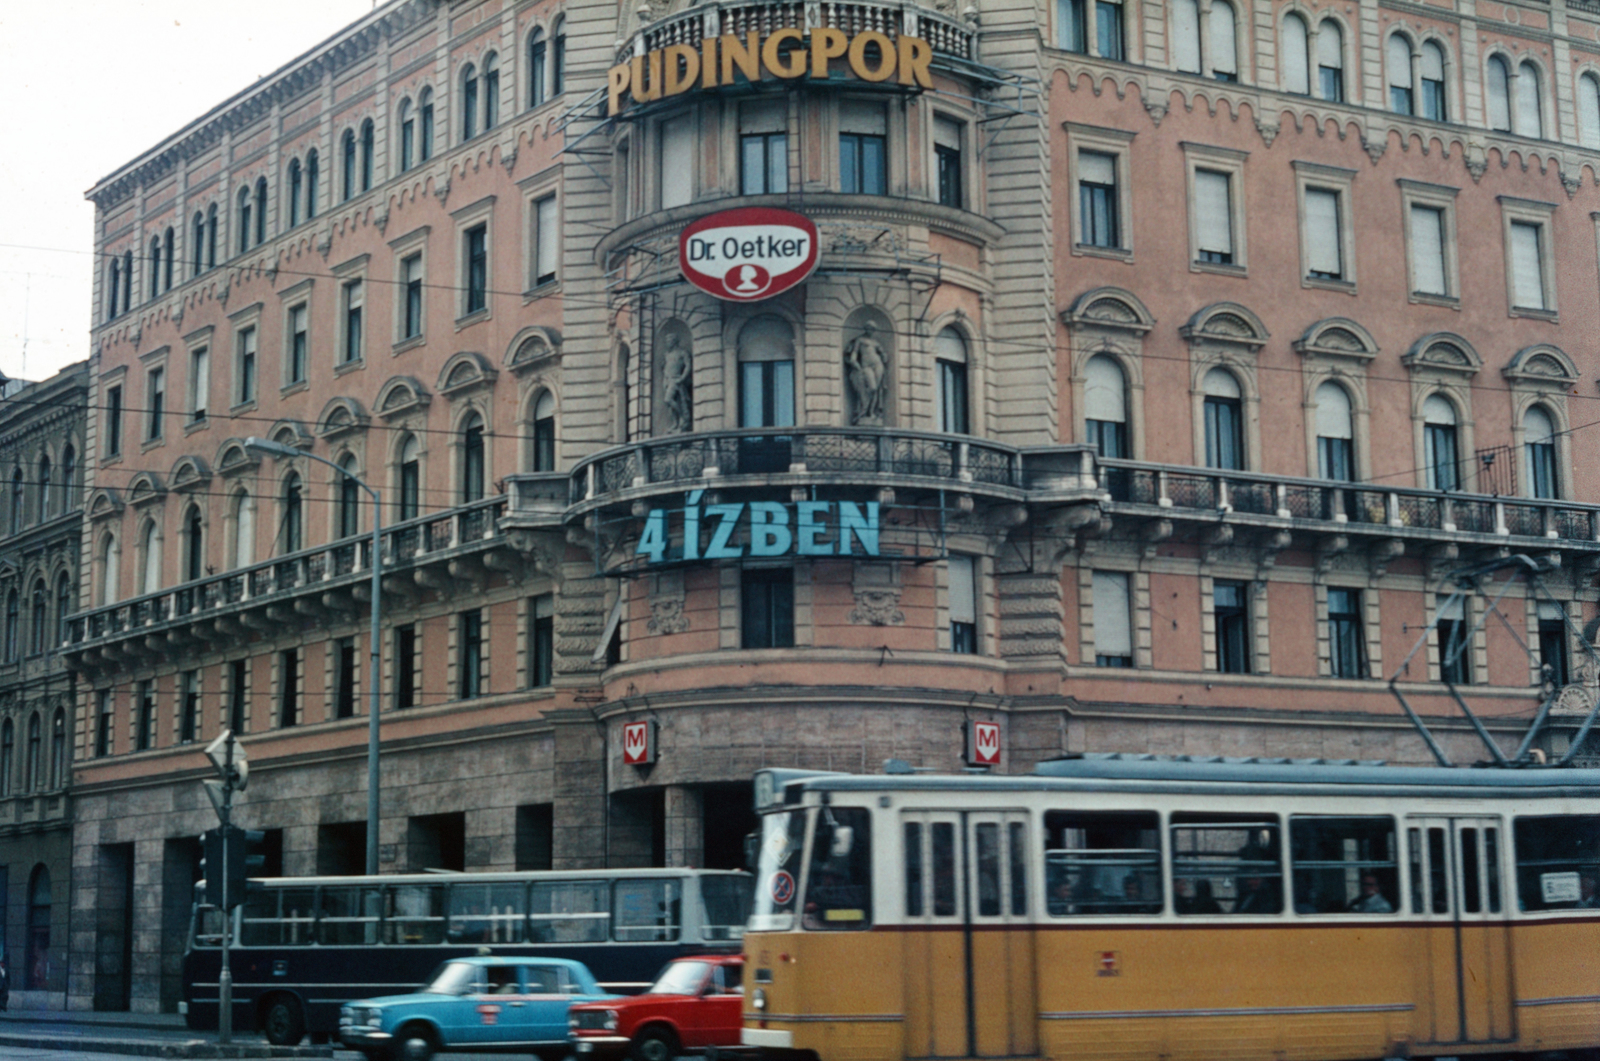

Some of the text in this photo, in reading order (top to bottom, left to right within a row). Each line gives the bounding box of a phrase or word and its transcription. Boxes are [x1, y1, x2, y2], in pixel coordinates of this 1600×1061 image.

[607, 27, 936, 116] PUDINGPOR
[690, 235, 807, 261] Dr. Oetker
[636, 488, 880, 563] 4 ÍZBEN
[627, 728, 644, 748] M
[979, 728, 996, 748] M
